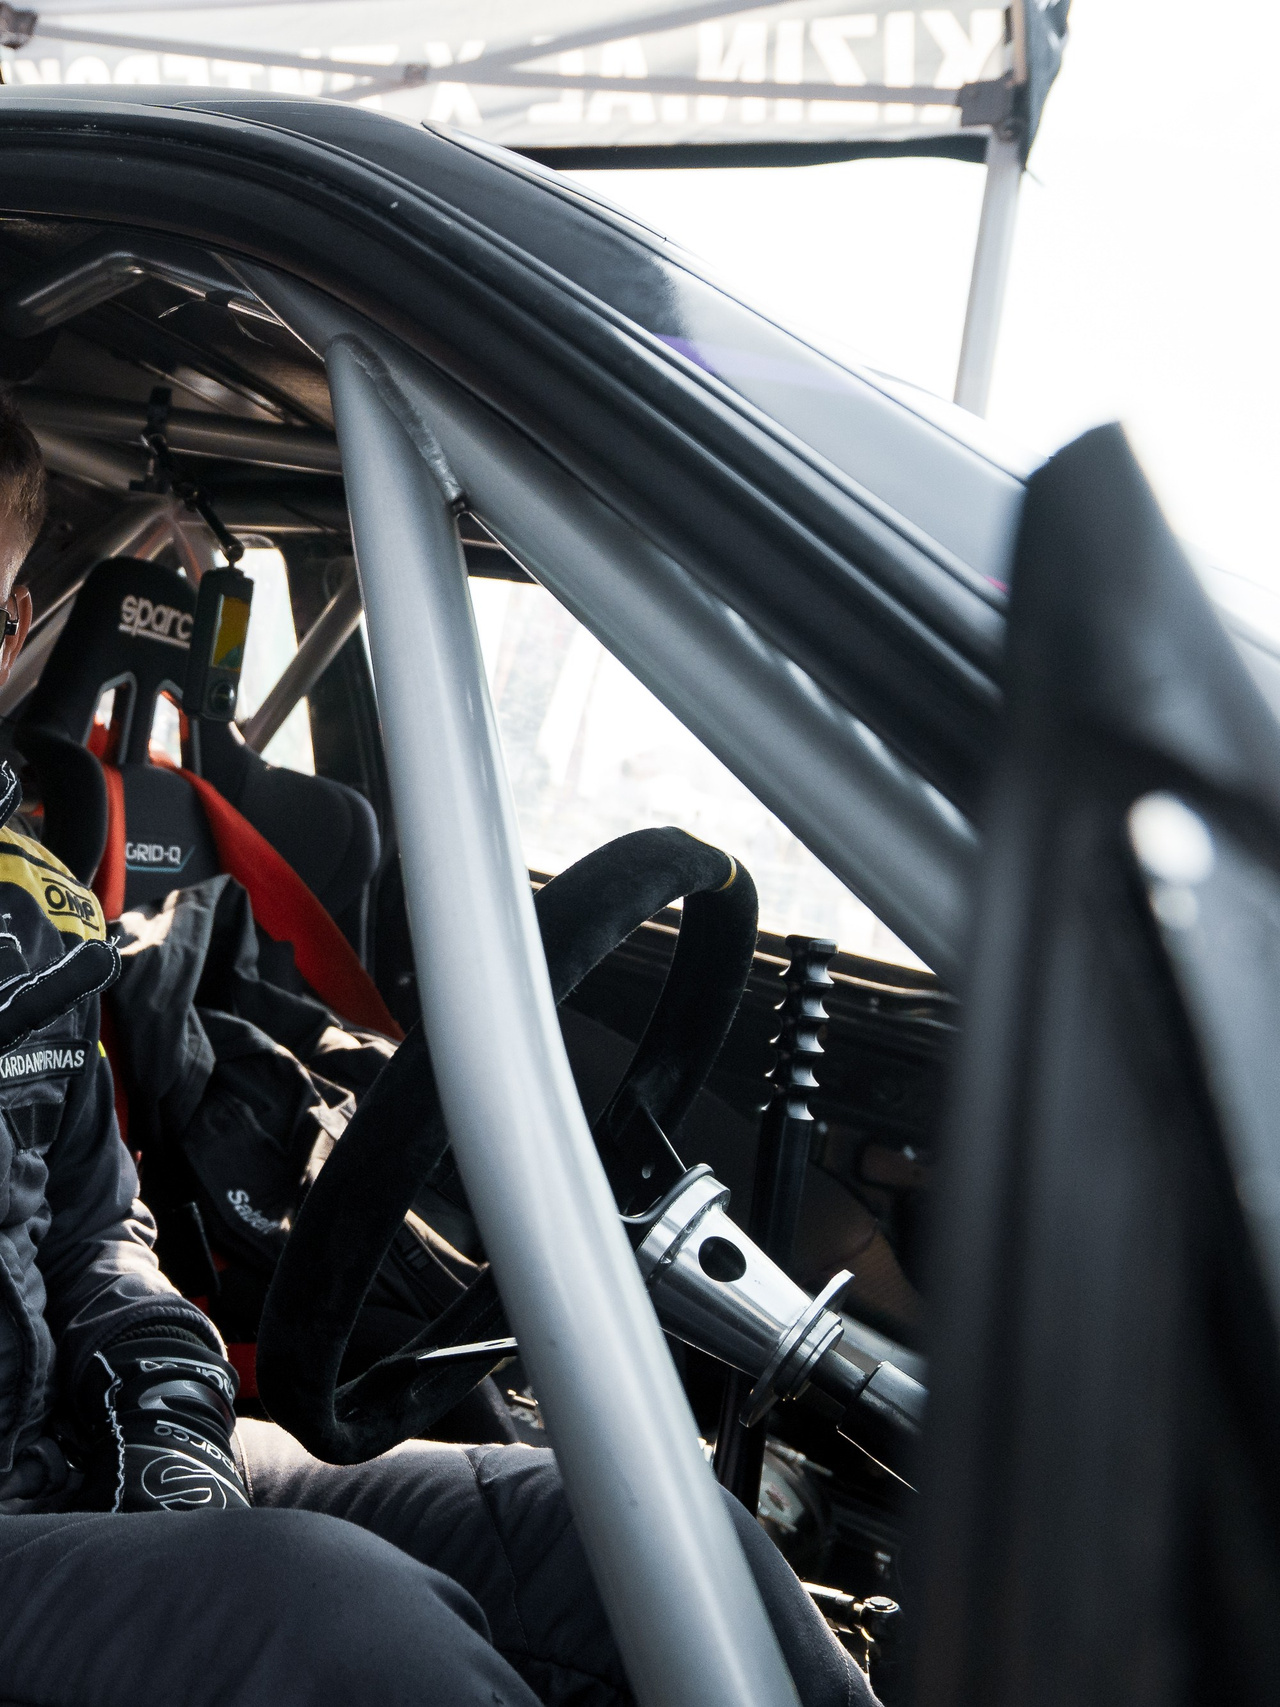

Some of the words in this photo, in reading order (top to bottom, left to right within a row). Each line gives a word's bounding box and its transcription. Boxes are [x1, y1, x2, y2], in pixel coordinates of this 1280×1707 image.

[122, 595, 194, 641] sparc
[125, 842, 181, 865] GRID-Q
[44, 884, 96, 921] OMP
